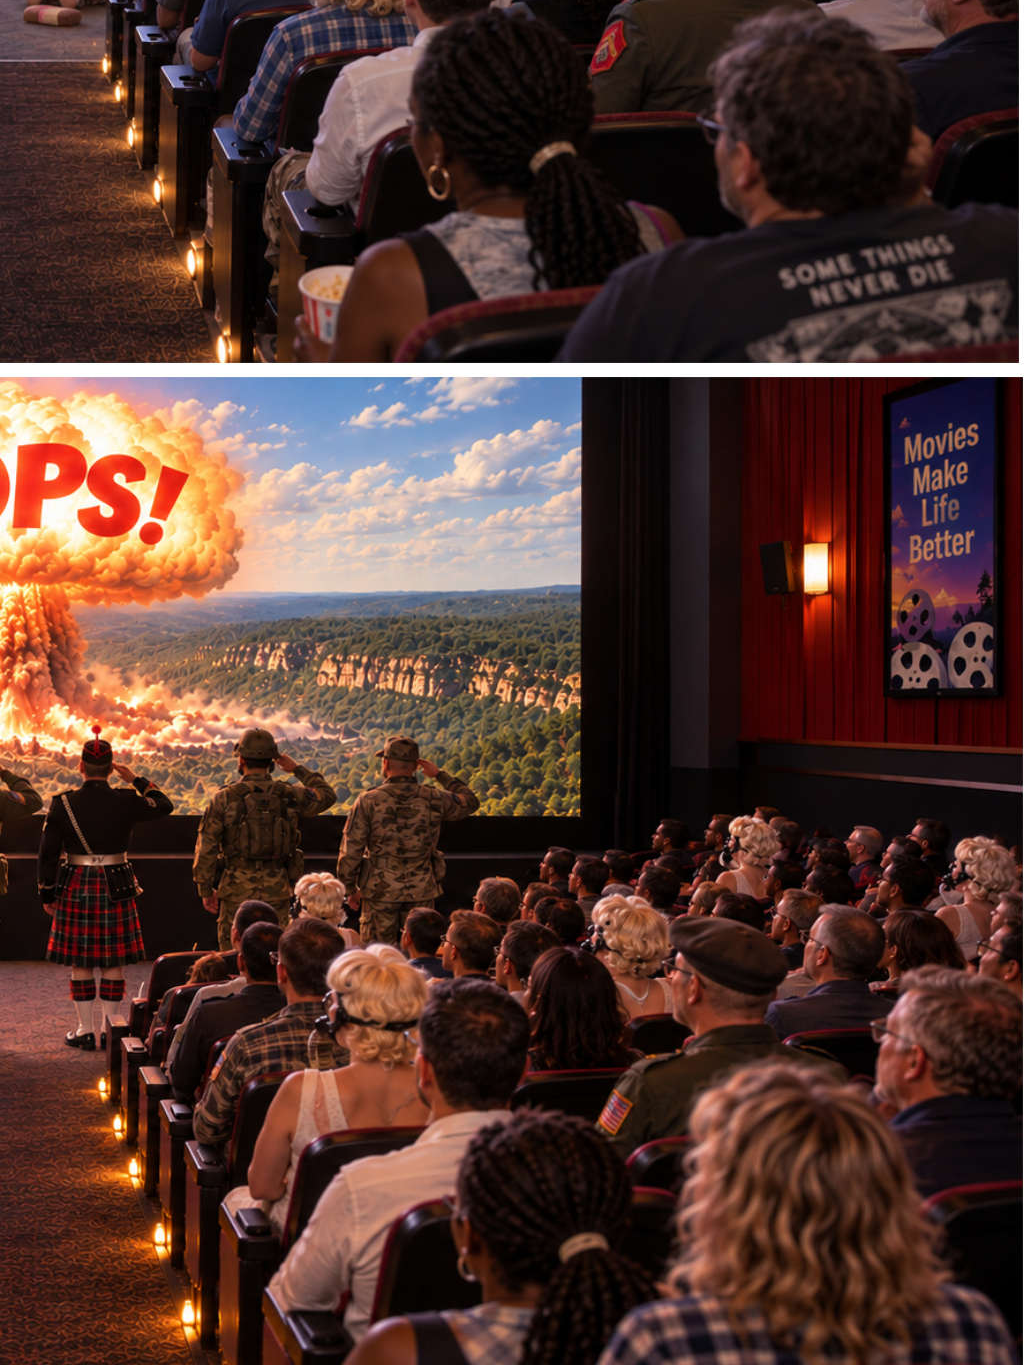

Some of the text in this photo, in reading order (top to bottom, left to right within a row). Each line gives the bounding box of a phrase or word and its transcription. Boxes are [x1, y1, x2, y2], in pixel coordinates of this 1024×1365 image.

[779, 234, 955, 290] SOME THINGS
[809, 259, 953, 308] NEVER DIE
[904, 422, 979, 465] Movies
[912, 459, 968, 496] Make
[921, 494, 960, 527] Life
[908, 529, 975, 564] Better
